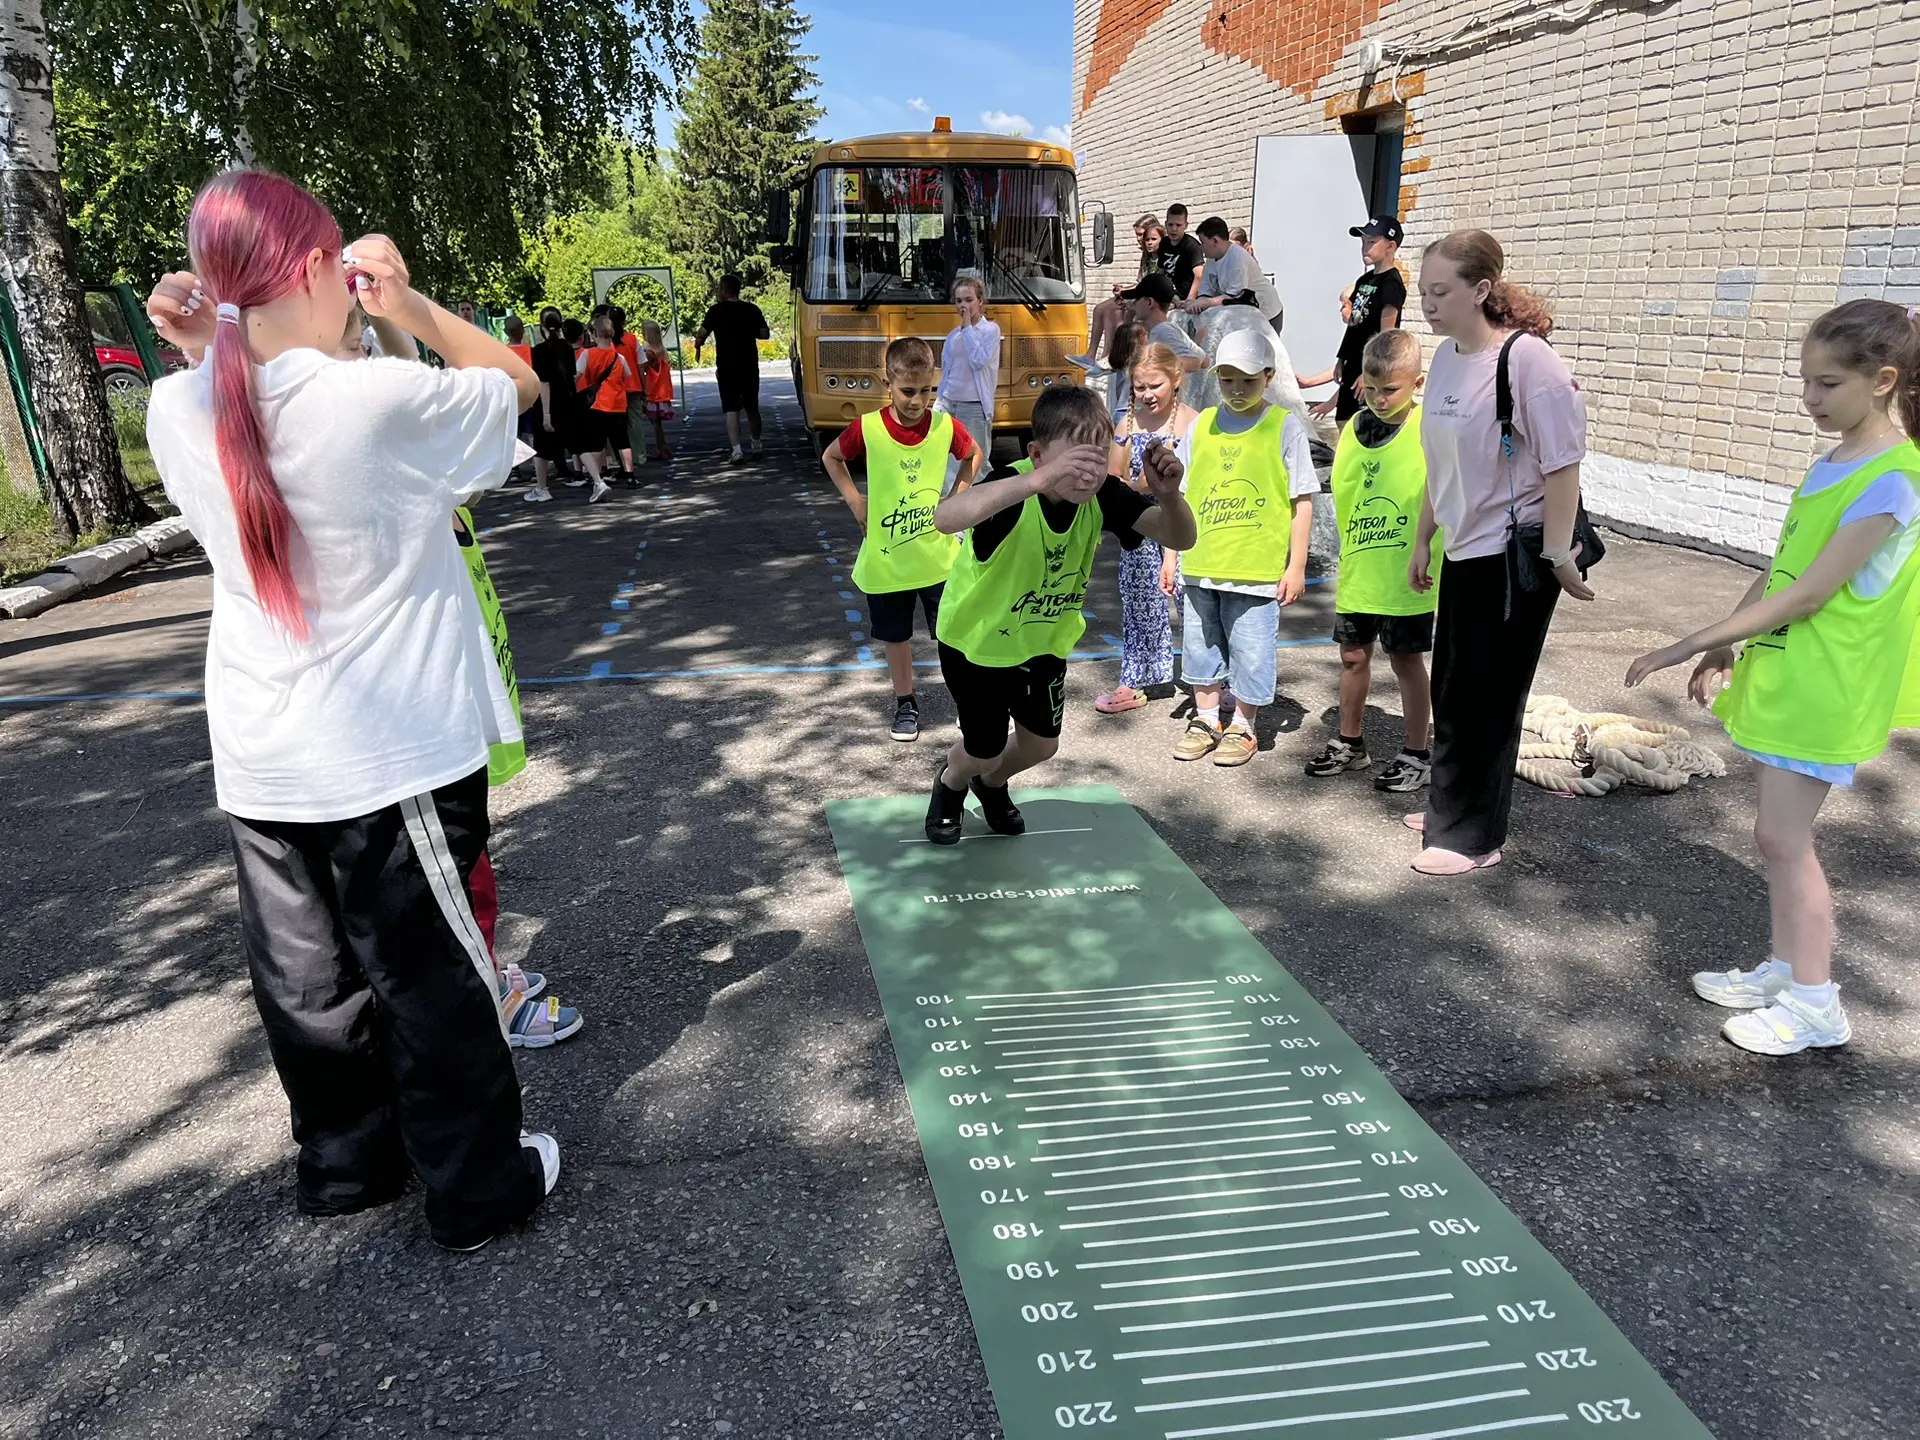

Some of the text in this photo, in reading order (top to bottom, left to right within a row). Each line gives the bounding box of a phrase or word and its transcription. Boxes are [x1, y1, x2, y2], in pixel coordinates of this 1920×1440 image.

[1213, 510, 1259, 525] ШКОЛЕ
[1358, 529, 1403, 545] ШКОЛЕ
[923, 884, 1141, 904] www.atlet-sport.ru
[1226, 975, 1262, 984] 100
[916, 995, 953, 1005] 100
[1244, 994, 1280, 1003] 110
[925, 1017, 962, 1027] 110
[1261, 1015, 1299, 1025] 120
[932, 1040, 971, 1052] 120
[1280, 1037, 1320, 1048] 130
[940, 1065, 981, 1077] 130
[1301, 1064, 1342, 1076] 140
[949, 1092, 991, 1106] 140
[1322, 1092, 1365, 1105] 150
[959, 1122, 1003, 1137] 150
[1346, 1120, 1390, 1135] 160
[970, 1156, 1015, 1170] 160
[1371, 1150, 1418, 1165] 170
[981, 1188, 1028, 1204] 170
[1399, 1183, 1448, 1198] 180
[993, 1223, 1043, 1239] 180
[1429, 1218, 1480, 1235] 190
[1007, 1261, 1059, 1280] 190
[1462, 1256, 1517, 1276] 200
[1022, 1302, 1077, 1322] 200
[1497, 1300, 1555, 1323] 210
[1038, 1350, 1096, 1373] 210
[1536, 1348, 1596, 1370] 220
[1055, 1402, 1117, 1428] 220
[1578, 1399, 1640, 1423] 230
